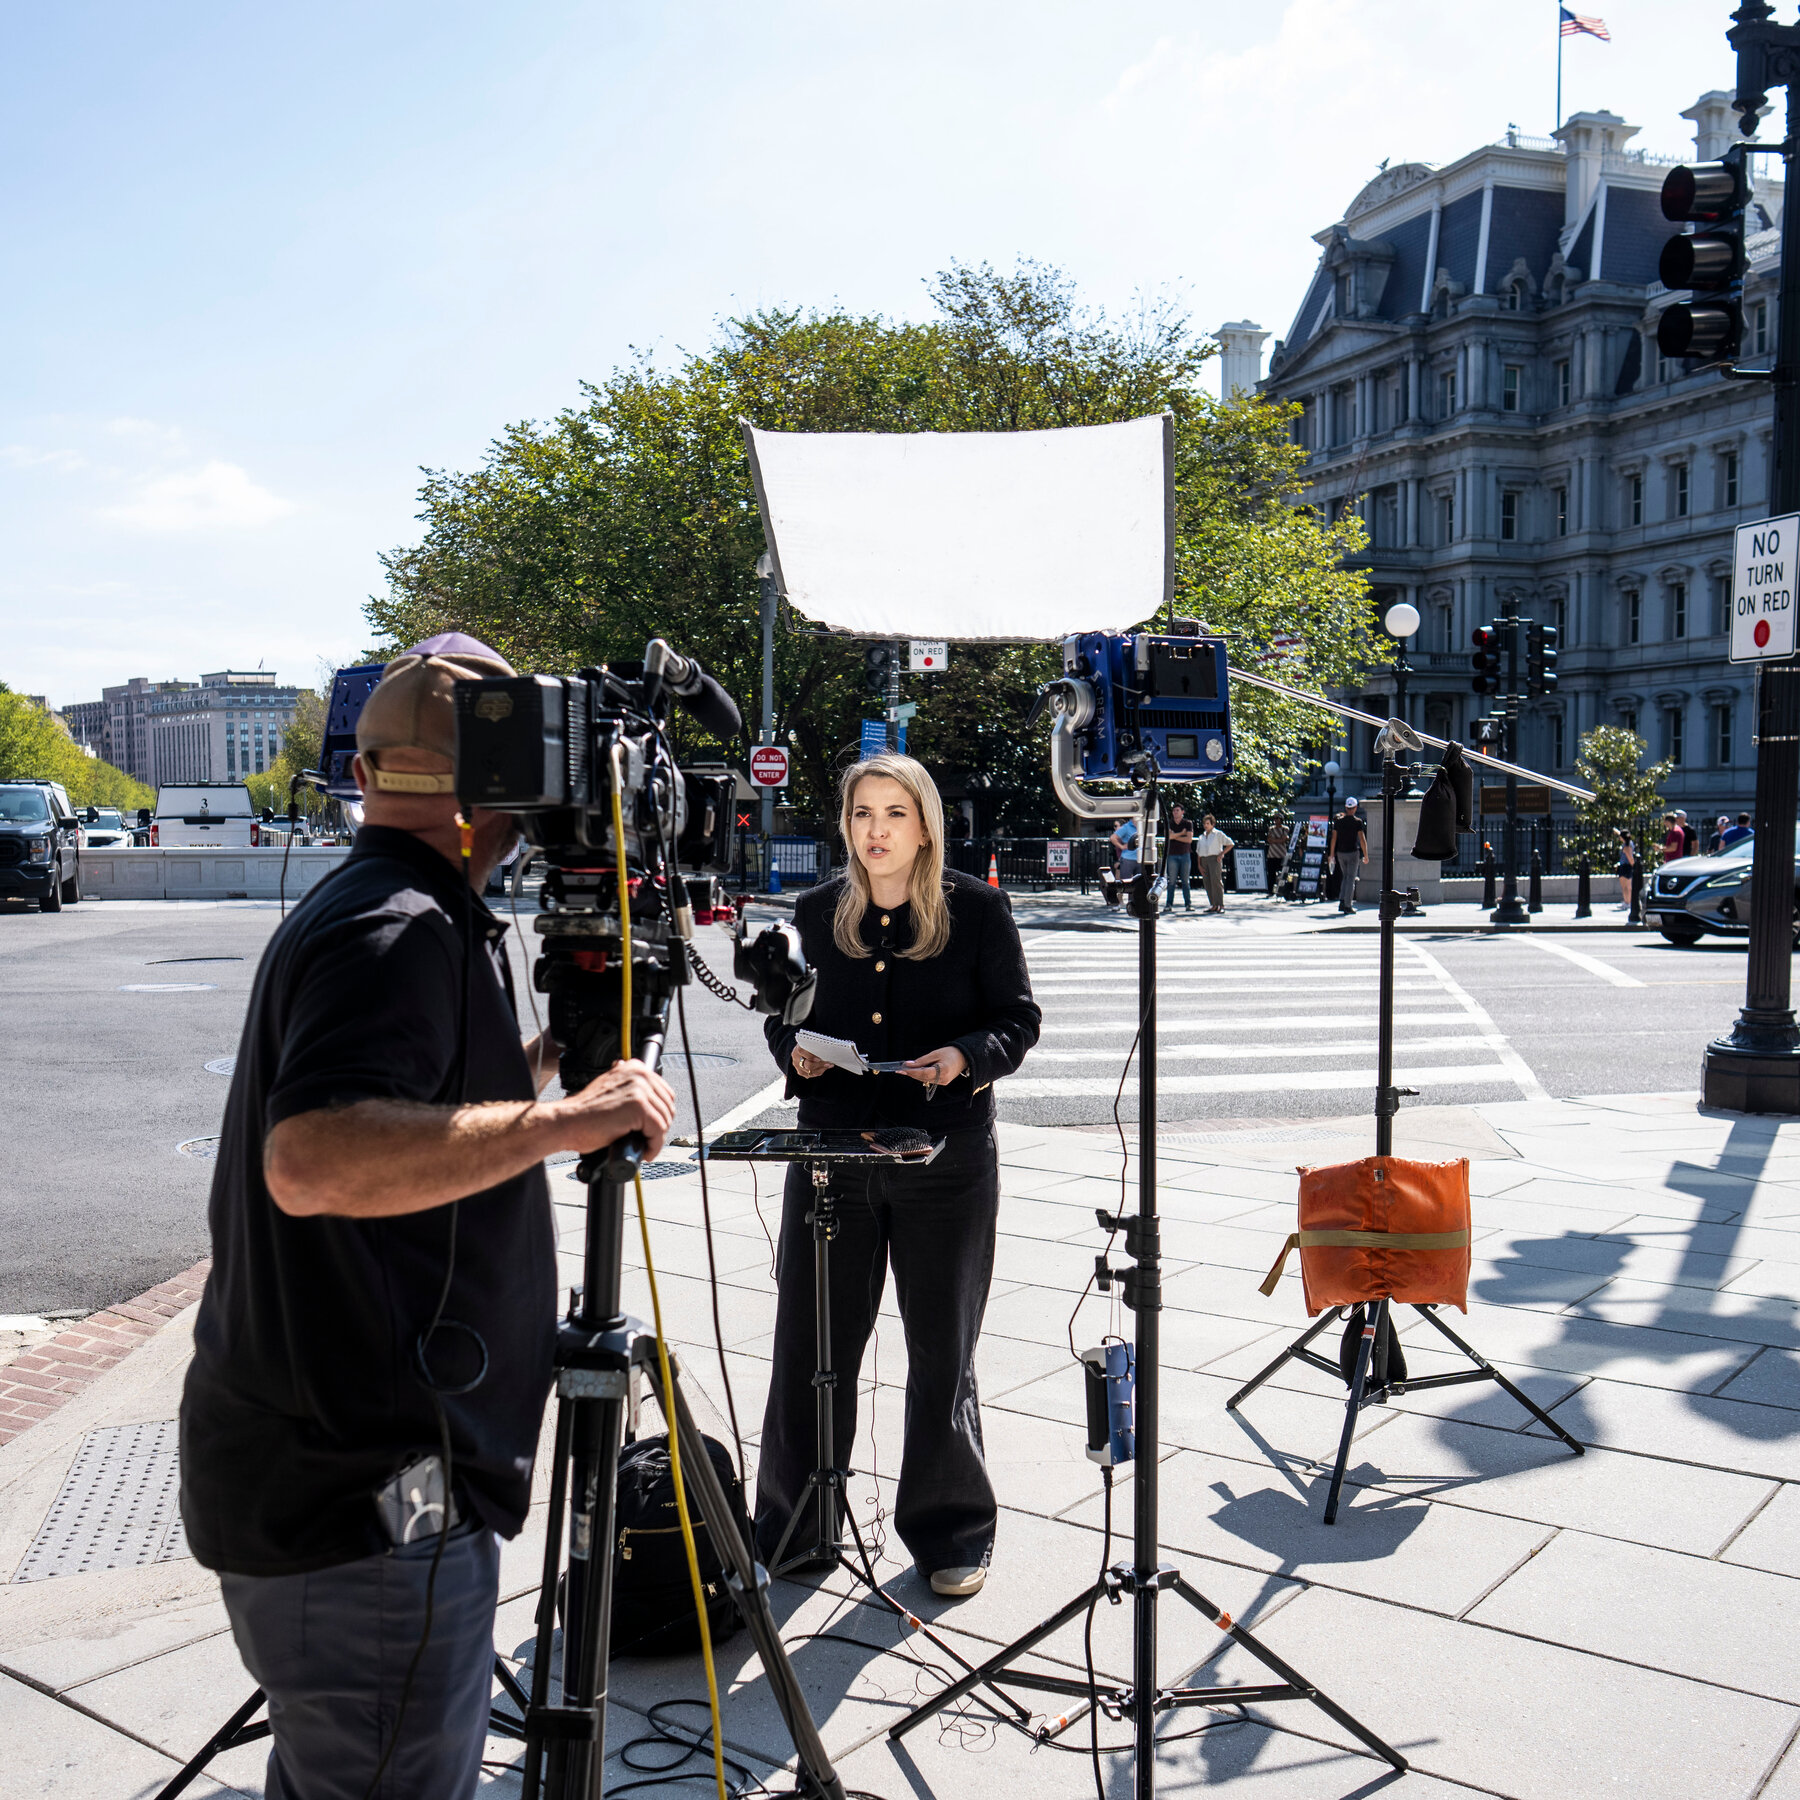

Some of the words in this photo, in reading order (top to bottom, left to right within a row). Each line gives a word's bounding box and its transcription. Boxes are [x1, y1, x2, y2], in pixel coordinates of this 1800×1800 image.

[1752, 529, 1780, 558] NO
[1747, 561, 1784, 587] TURN
[1737, 594, 1756, 616] ON
[1762, 589, 1791, 613] RED
[1096, 686, 1105, 739] CREAM
[201, 798, 208, 809] 3
